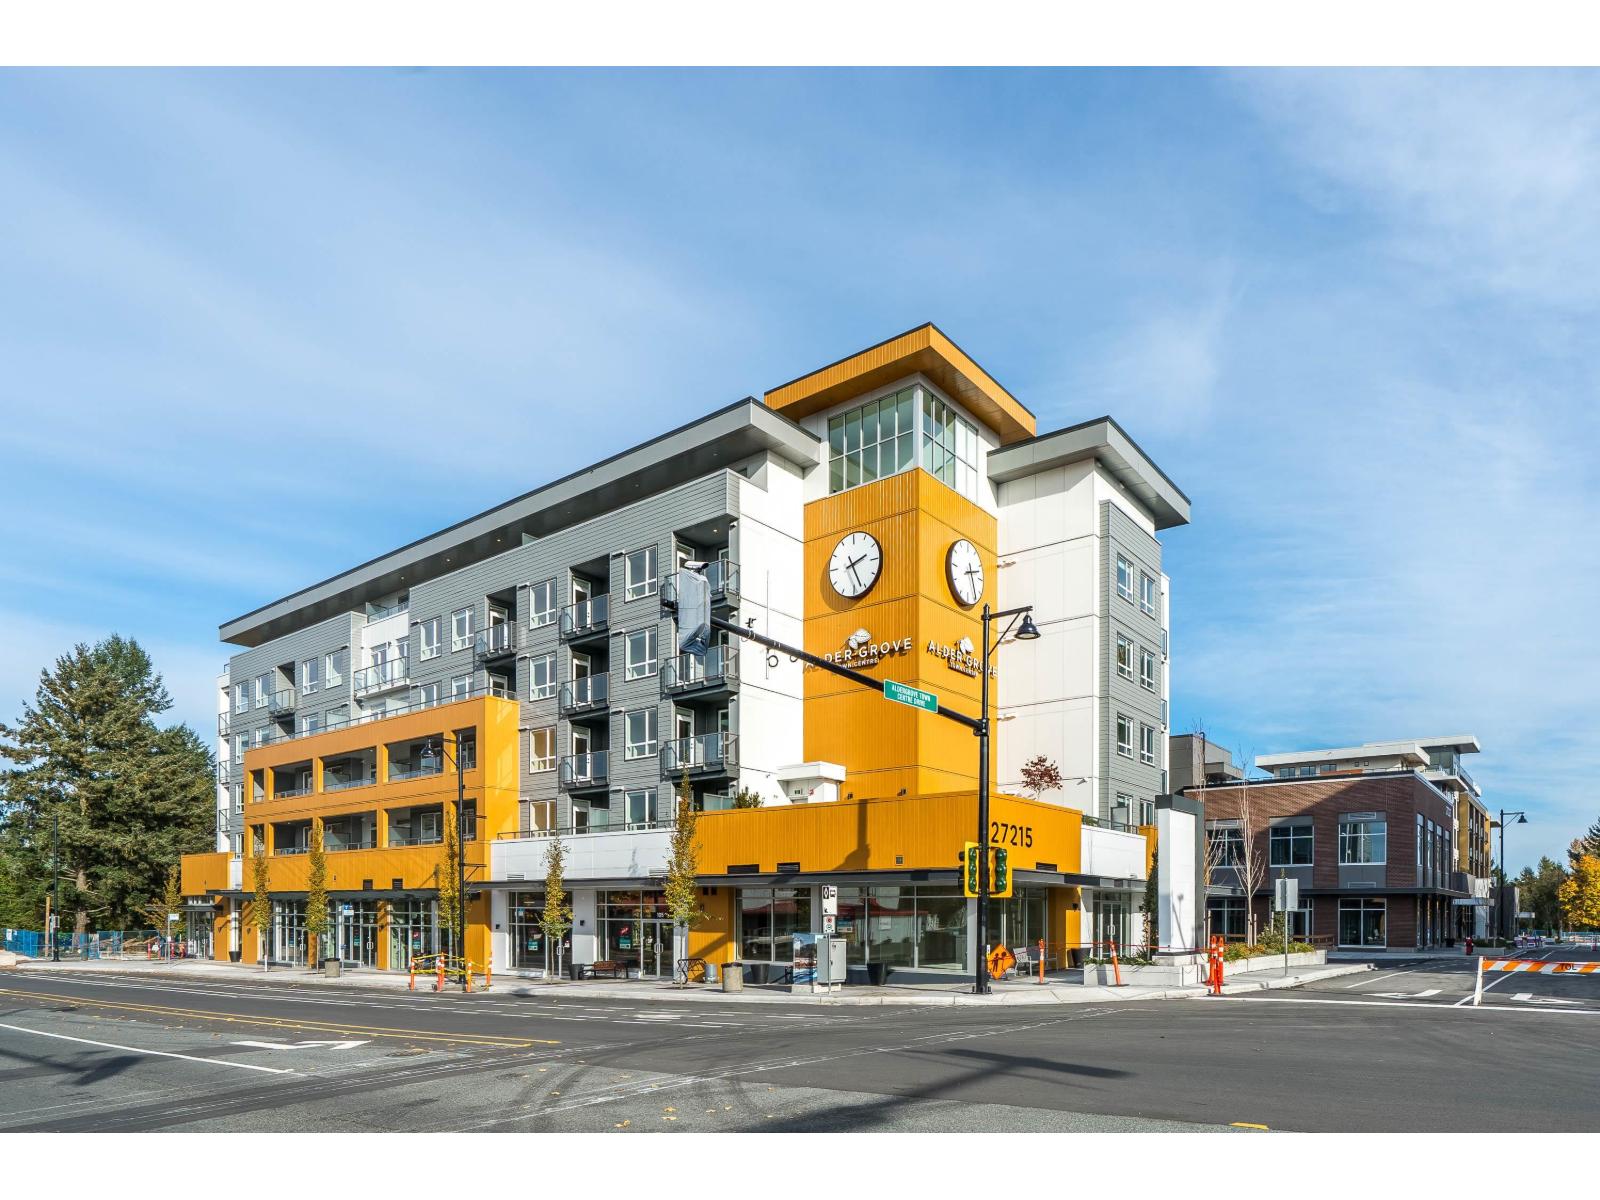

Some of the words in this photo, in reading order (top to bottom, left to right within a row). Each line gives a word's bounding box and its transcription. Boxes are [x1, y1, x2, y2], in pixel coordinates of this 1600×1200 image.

[859, 638, 912, 657] GROVE
[928, 640, 962, 662] ALDER
[897, 693, 913, 703] CENTRE
[919, 692, 931, 702] TOWN
[991, 821, 1033, 848] 27215
